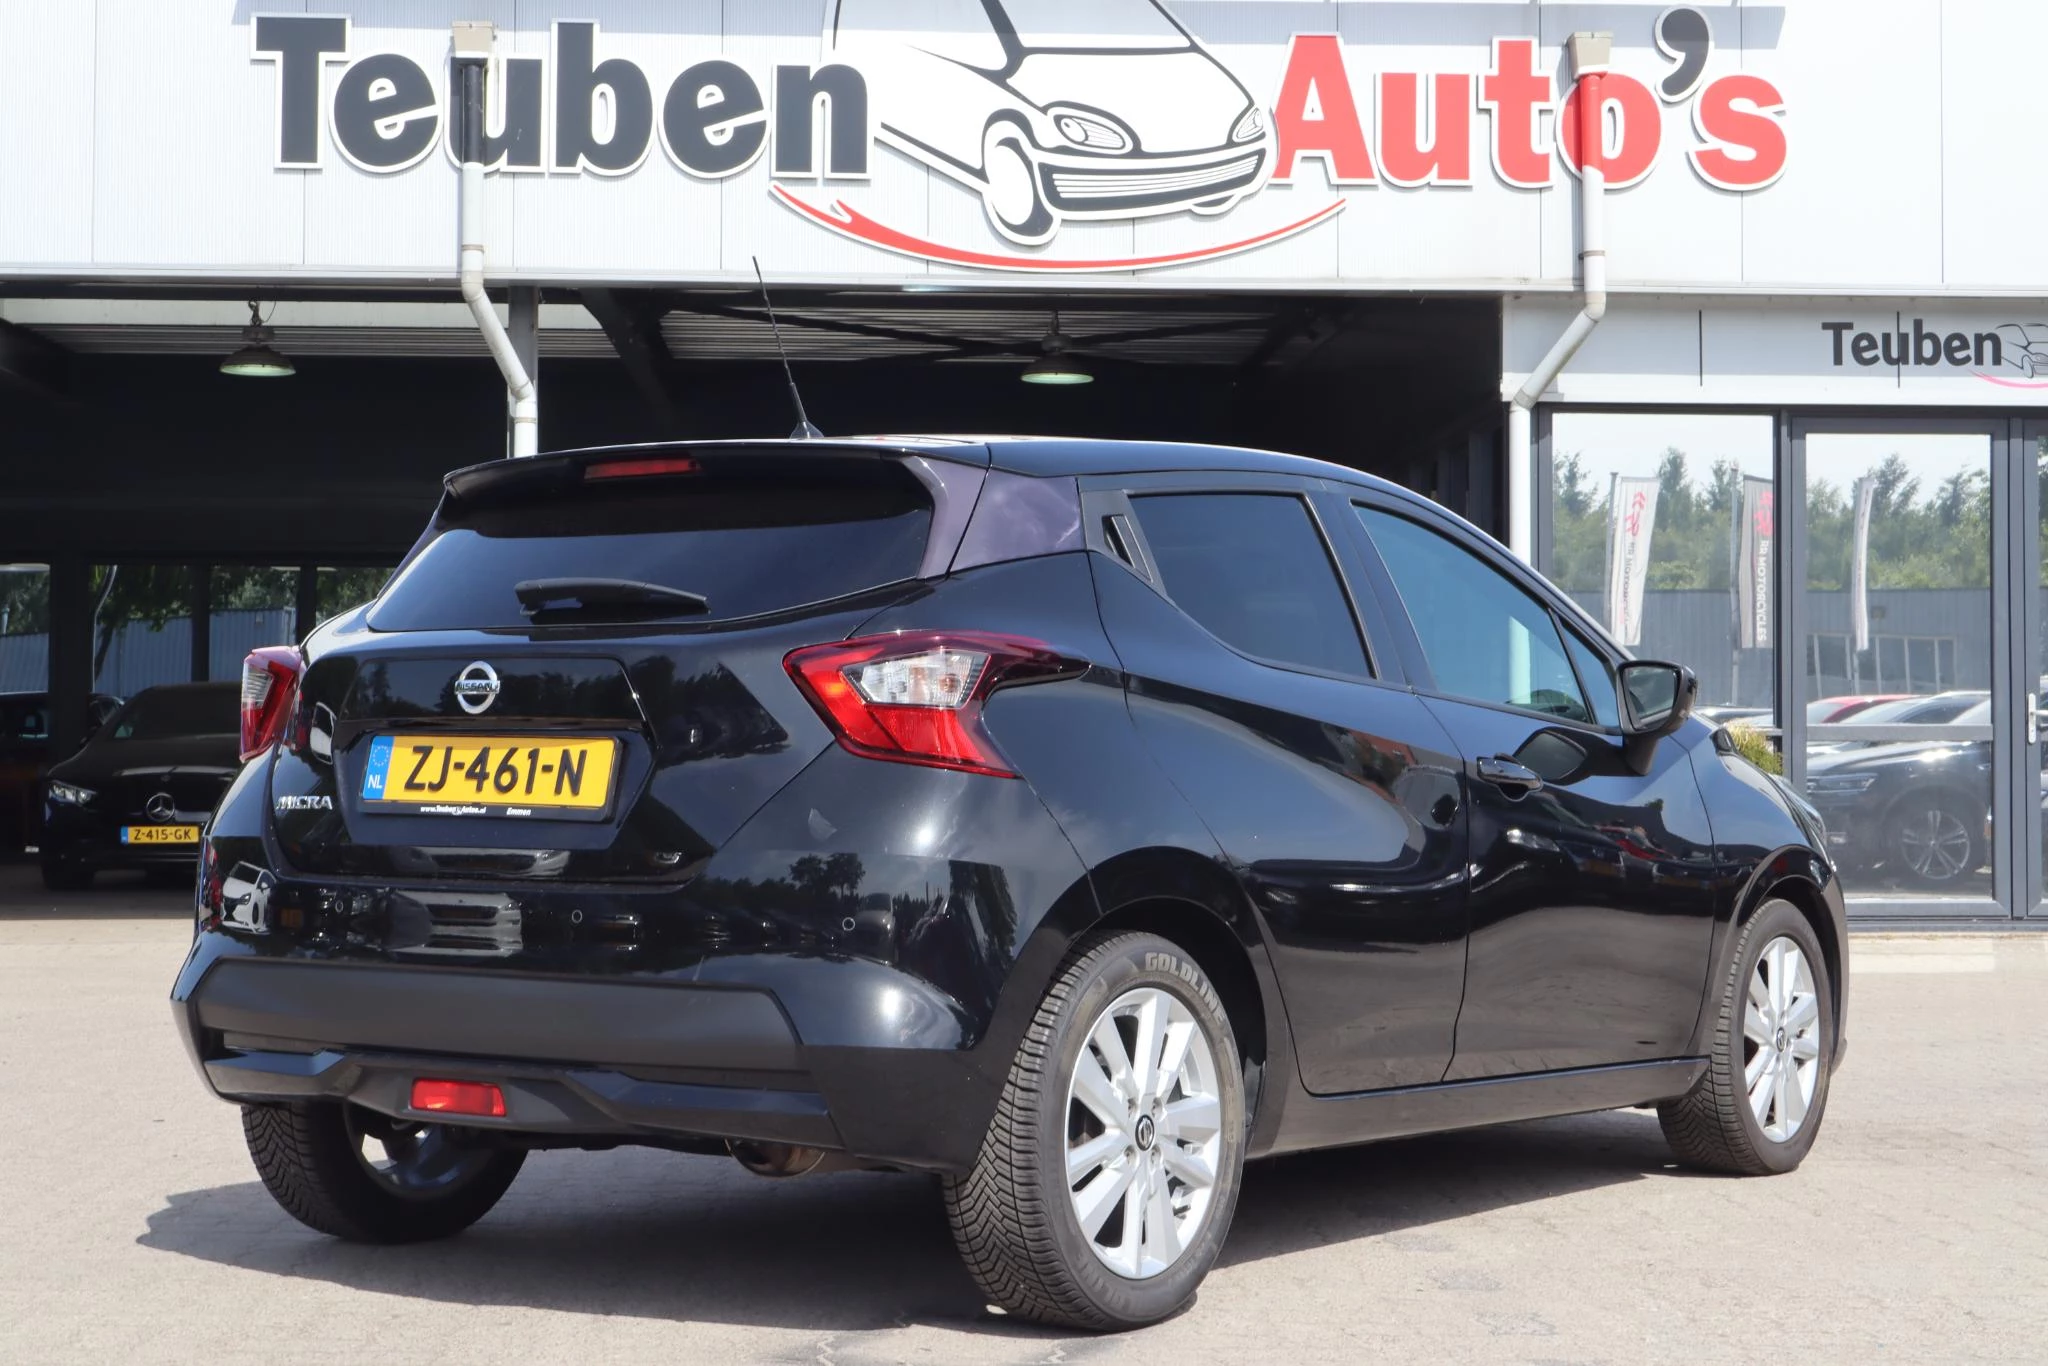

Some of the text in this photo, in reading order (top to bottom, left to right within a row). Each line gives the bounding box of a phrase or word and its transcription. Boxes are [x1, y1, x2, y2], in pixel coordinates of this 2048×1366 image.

[253, 8, 1787, 187] Teuben Auto's
[1821, 318, 2003, 367] Teuben
[1756, 539, 1769, 642] RR MOTORCYCLES
[456, 681, 493, 692] NISSAN
[367, 774, 383, 789] NL
[403, 745, 588, 797] ZJ-461-N
[275, 795, 334, 811] MICRA
[506, 806, 532, 816] Emmen
[133, 828, 192, 841] Z-415-GK
[1144, 951, 1225, 1024] GOLDLINE
